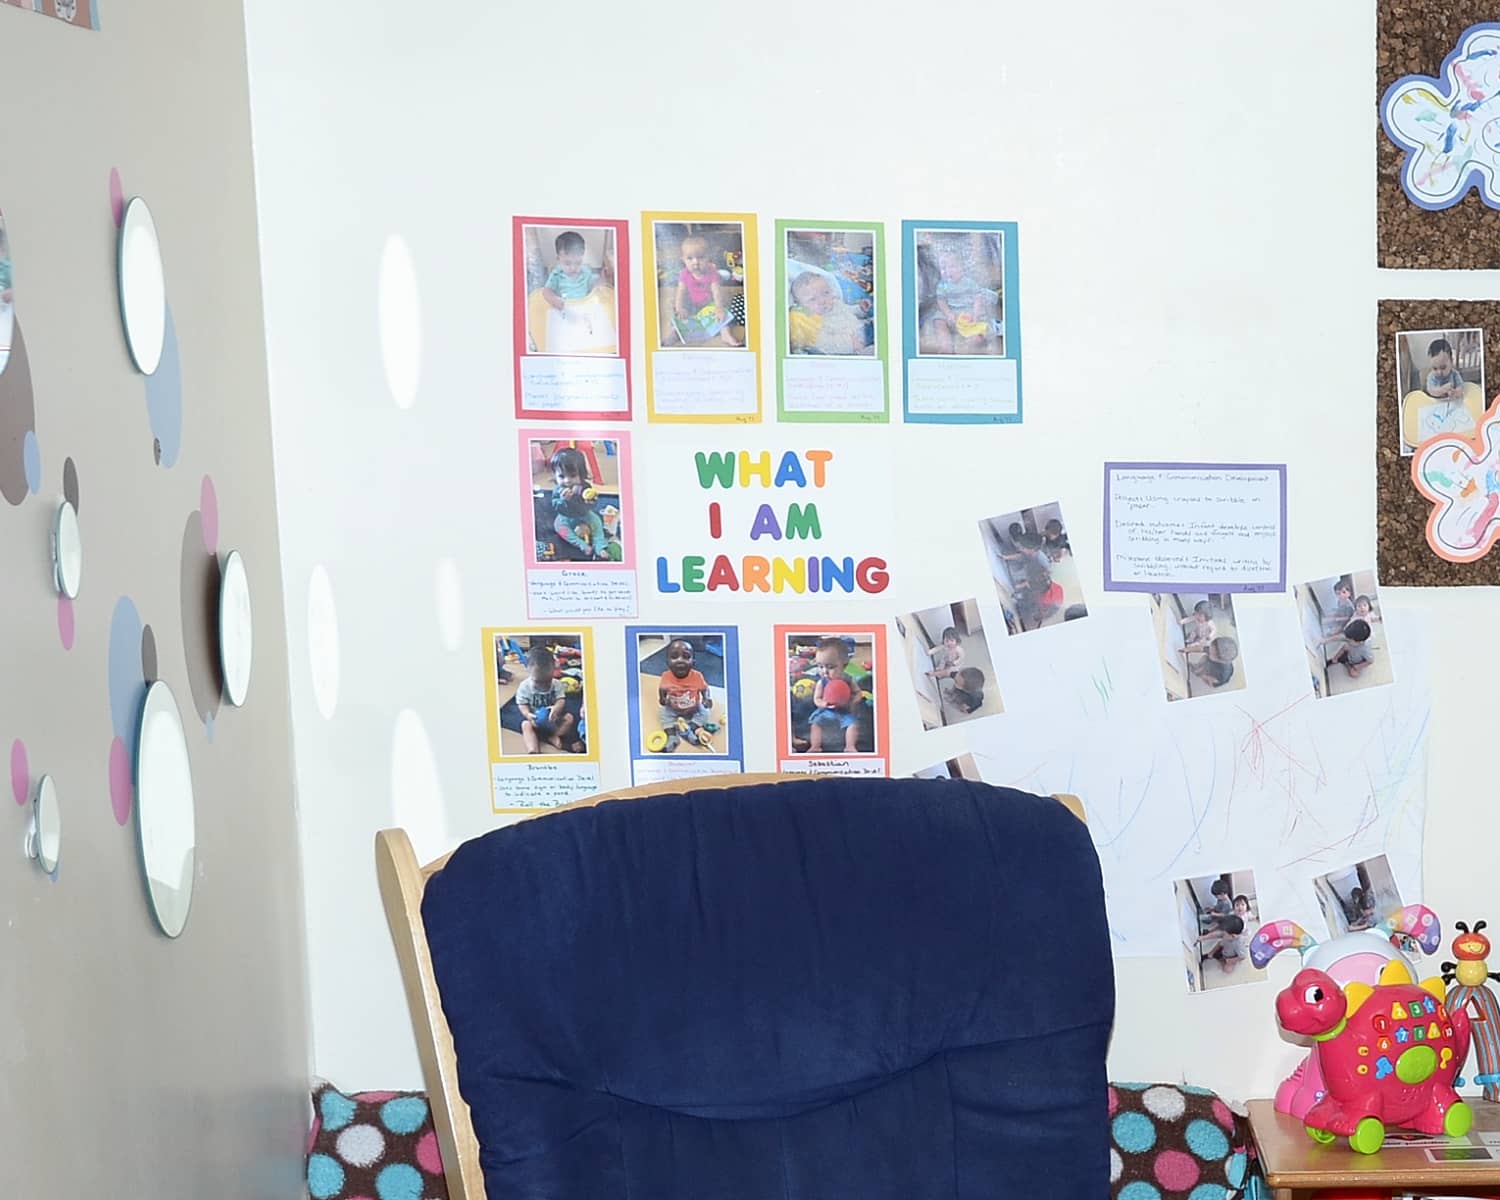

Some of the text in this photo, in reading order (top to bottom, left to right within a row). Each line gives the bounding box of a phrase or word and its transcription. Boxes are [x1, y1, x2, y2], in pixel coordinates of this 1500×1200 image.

[694, 450, 833, 489] WHAT
[709, 502, 822, 541] I AM
[656, 554, 890, 594] LEARNING
